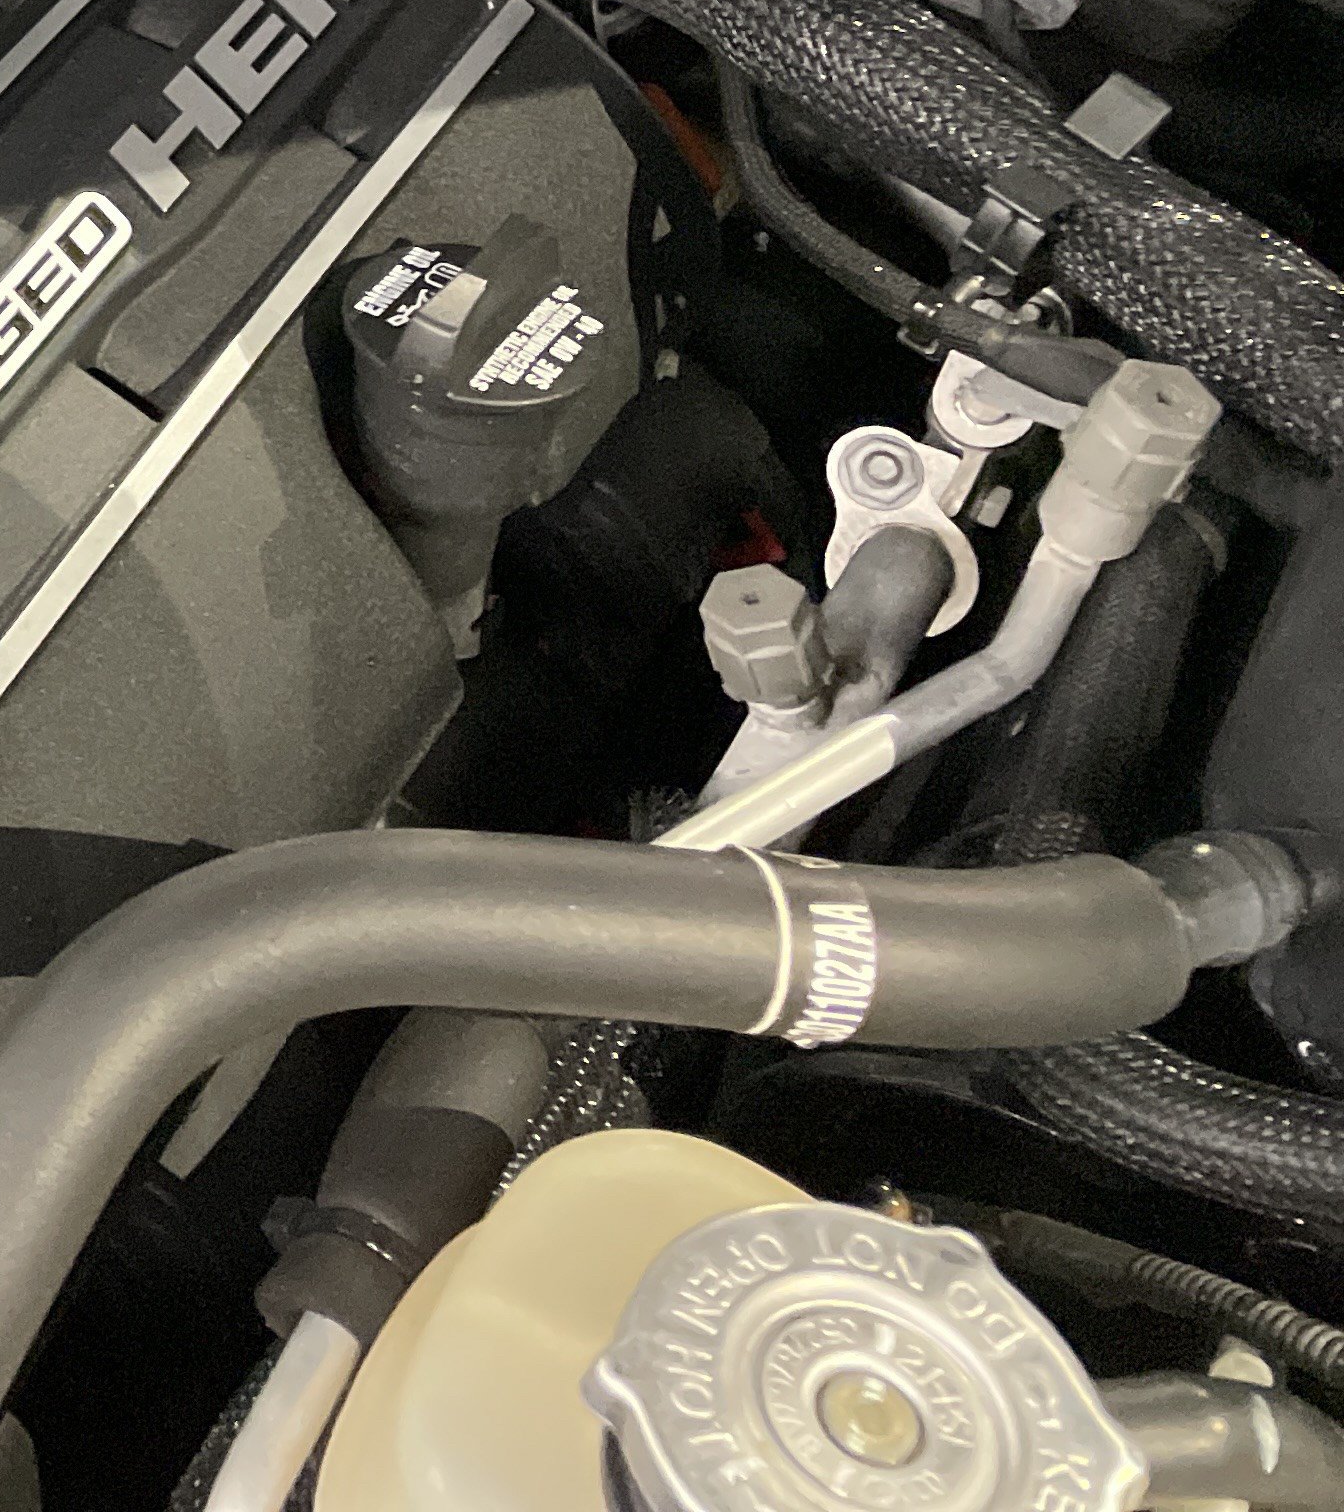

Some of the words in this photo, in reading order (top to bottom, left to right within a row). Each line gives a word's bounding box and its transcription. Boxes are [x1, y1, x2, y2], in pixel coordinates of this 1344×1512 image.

[354, 264, 422, 317] ENGINE
[402, 246, 441, 269] OIL
[469, 331, 528, 392] SYNTHETIC
[525, 358, 563, 391] SAE
[672, 1232, 794, 1335] OPEN
[812, 1228, 925, 1291] NOT
[945, 1279, 1028, 1358] DO
[666, 1344, 739, 1450] HOT
